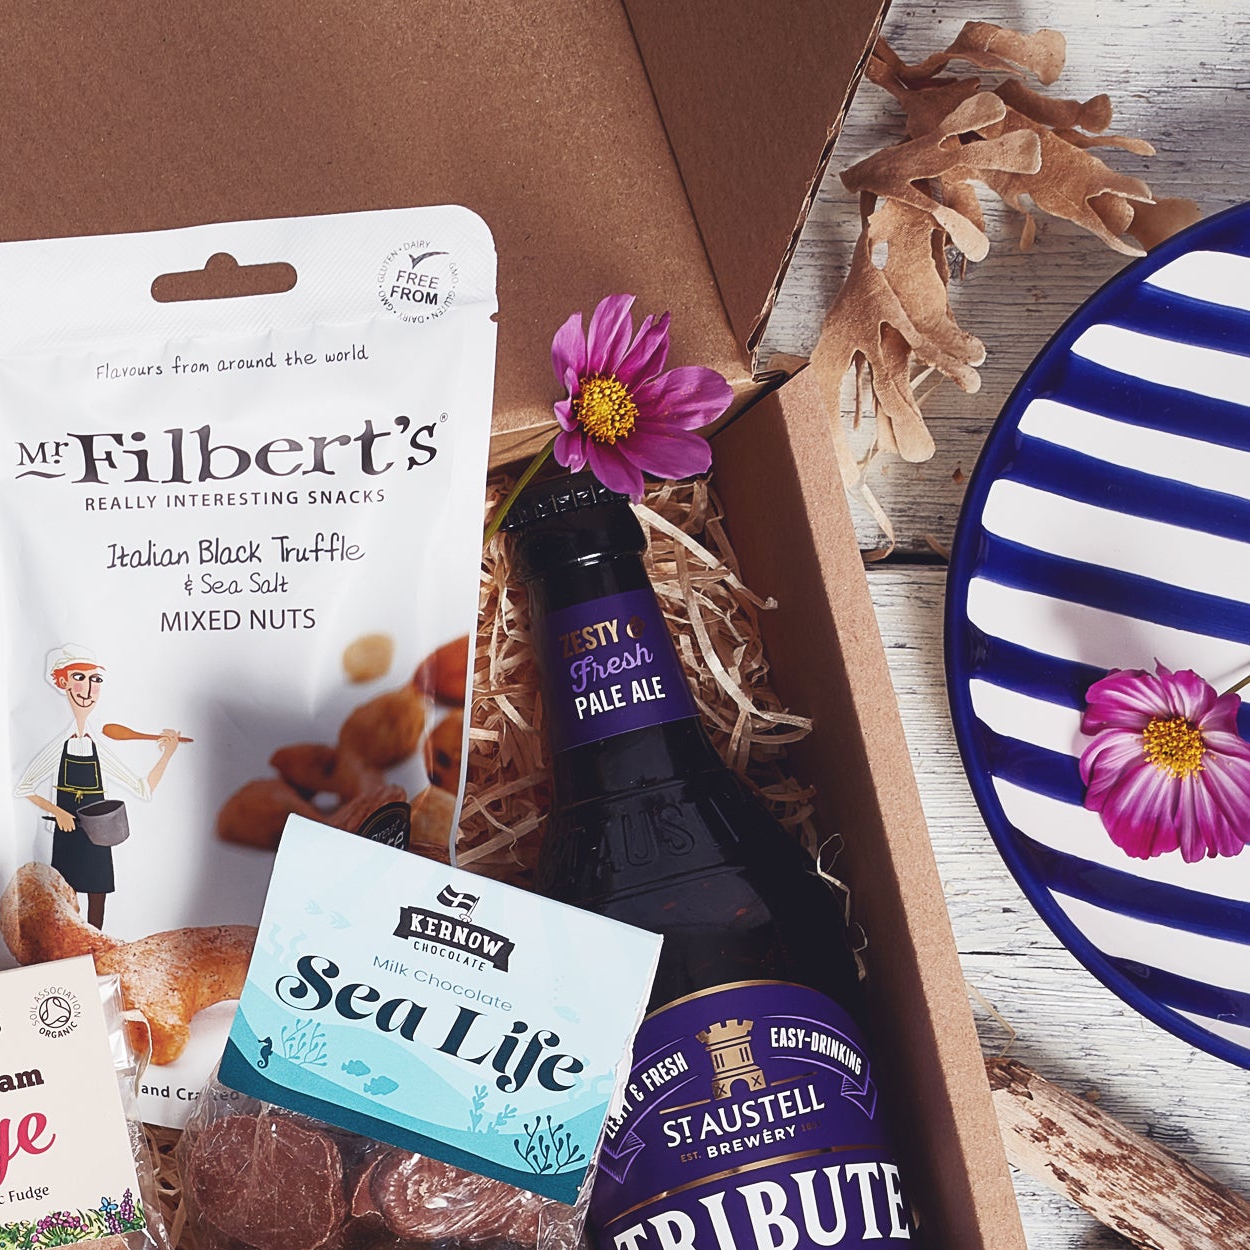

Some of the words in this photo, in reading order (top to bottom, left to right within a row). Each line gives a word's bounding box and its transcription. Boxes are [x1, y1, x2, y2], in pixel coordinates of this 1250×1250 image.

[390, 285, 438, 305] FROM
[396, 270, 440, 289] FREE
[96, 359, 164, 380] Flavours
[172, 356, 210, 374] from
[217, 352, 277, 371] around
[285, 350, 317, 366] the
[325, 345, 369, 362] world
[66, 415, 440, 485] Filbert's
[85, 493, 157, 511] REALLY
[166, 490, 299, 507] INTERESTING
[308, 489, 386, 505] SNACKS
[107, 541, 189, 570] Italian
[199, 537, 263, 565] Black
[271, 532, 366, 562] Truffle
[200, 573, 243, 594] Sea
[249, 572, 290, 594] Salt
[160, 610, 241, 632] MIXED
[249, 608, 317, 630] NUTS
[558, 618, 619, 659] ZESTY
[569, 642, 654, 693] Fresh
[574, 684, 626, 720] PALE
[632, 676, 666, 705] ALE
[409, 912, 504, 957] KERNOW
[413, 940, 486, 972] CHOCOLATE
[373, 955, 408, 977] Milk
[414, 968, 512, 1012] Chocolate
[30, 1005, 39, 1027] SOIL
[34, 986, 81, 1018] ASSOCIATION
[39, 1021, 78, 1038] ORGANIC
[275, 955, 428, 1042] Sea
[434, 1005, 585, 1094] Life
[770, 1027, 862, 1076] EASY-DRINKING
[141, 1085, 170, 1098] and
[629, 1084, 645, 1101] &
[641, 1052, 689, 1092] FRESH
[699, 1084, 825, 1143] AUSTELL
[8, 1184, 50, 1206] Fudge
